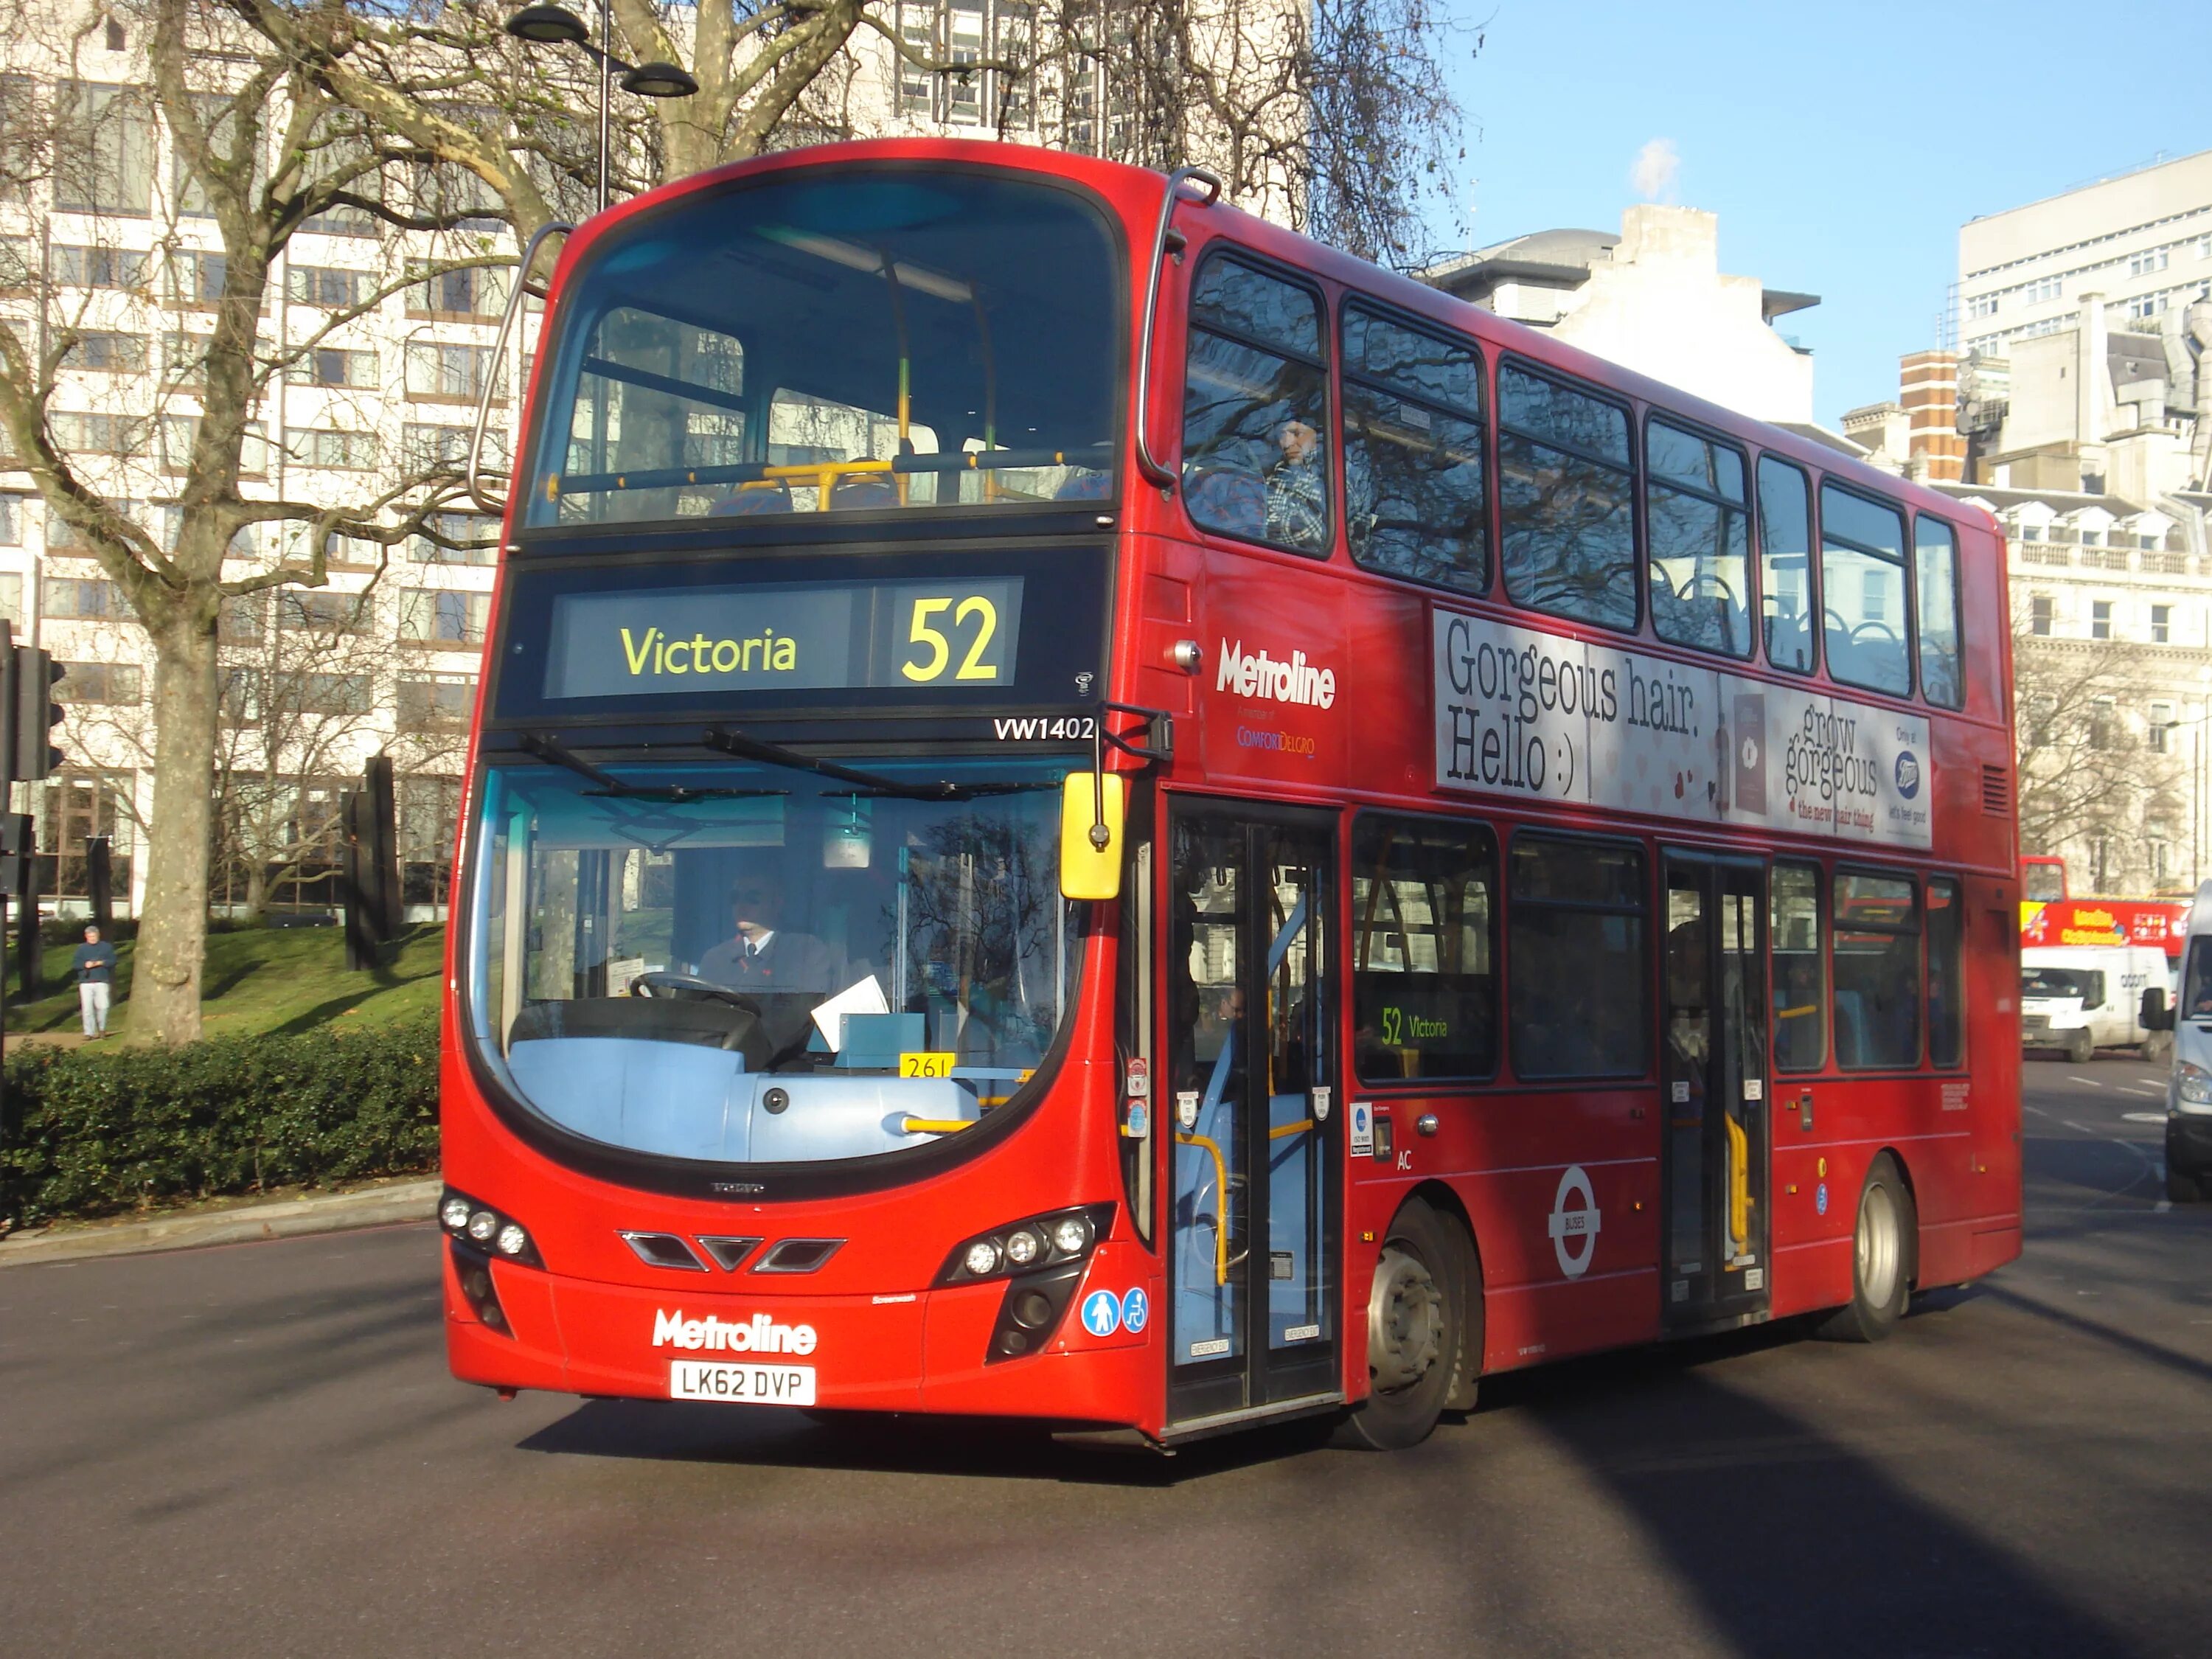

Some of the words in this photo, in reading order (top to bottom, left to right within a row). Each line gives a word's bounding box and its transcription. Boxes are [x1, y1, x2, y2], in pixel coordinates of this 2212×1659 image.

[620, 627, 797, 675] Victoria
[901, 596, 998, 683] 52
[1216, 637, 1336, 709] Metroline
[1447, 619, 1618, 725] Gorgeous
[1625, 658, 1699, 737] hair.
[994, 717, 1095, 740] VW1402
[1447, 705, 1547, 792] Hello
[1804, 703, 1856, 755] grow
[1786, 733, 1877, 801] gorgeous
[1798, 800, 1812, 820] the
[1813, 806, 1832, 822] new
[1853, 808, 1874, 834] thing
[1382, 1007, 1402, 1046] 52
[1409, 1014, 1447, 1037] Victoria
[908, 1057, 945, 1077] 261
[1397, 1150, 1412, 1171] AC
[1565, 1216, 1585, 1231] BUSES
[652, 1309, 818, 1356] Metroline
[683, 1367, 745, 1396] LK62
[754, 1371, 802, 1398] DVP
